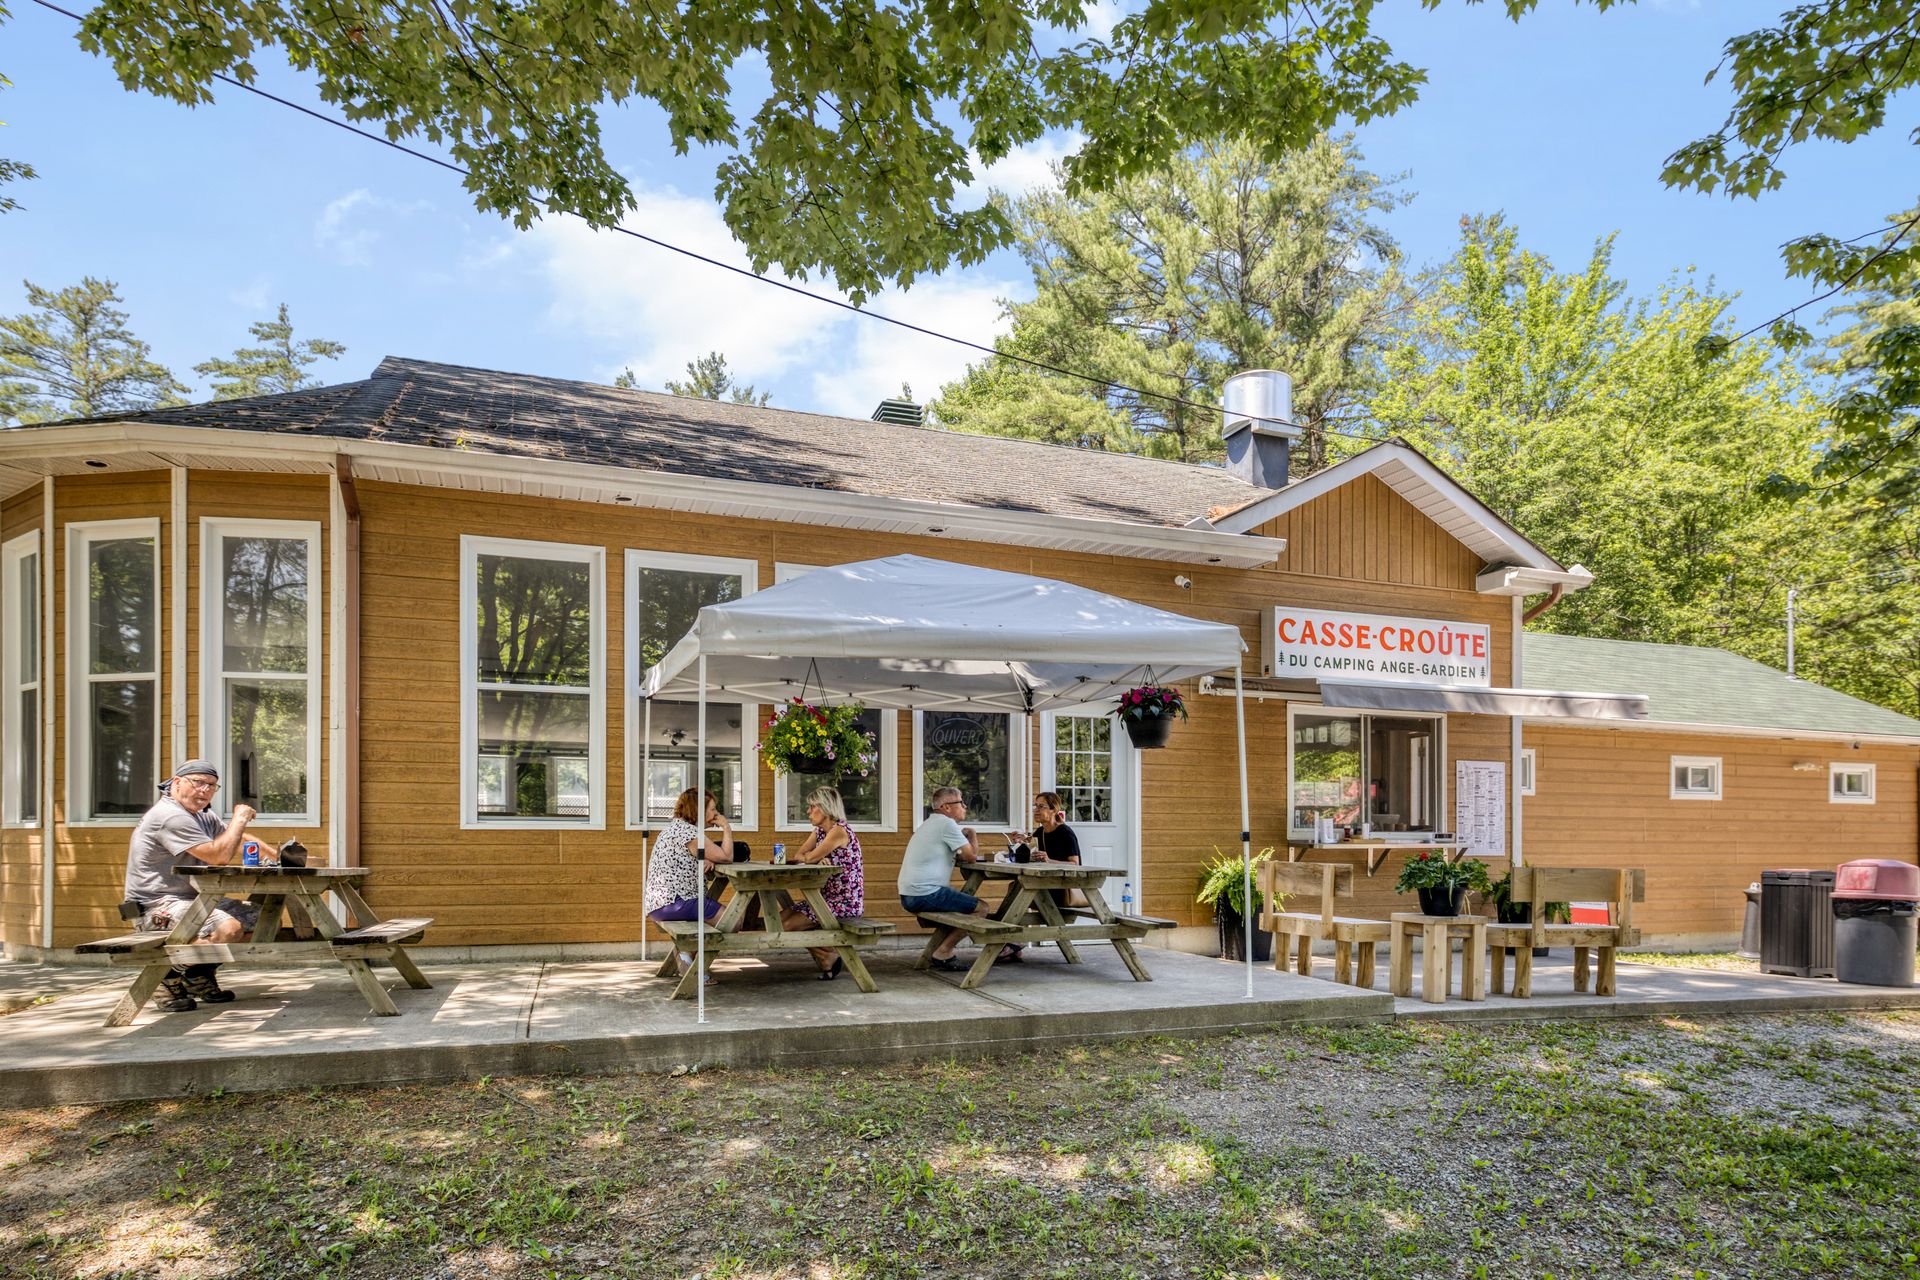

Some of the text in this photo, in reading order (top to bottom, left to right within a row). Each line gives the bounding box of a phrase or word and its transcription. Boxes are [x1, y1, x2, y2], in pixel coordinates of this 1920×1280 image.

[1278, 617, 1485, 658] CASSE-CROÛTE
[1289, 654, 1476, 678] DU CAMPING ANGE-GARDIEN
[935, 729, 984, 745] OUVERT
